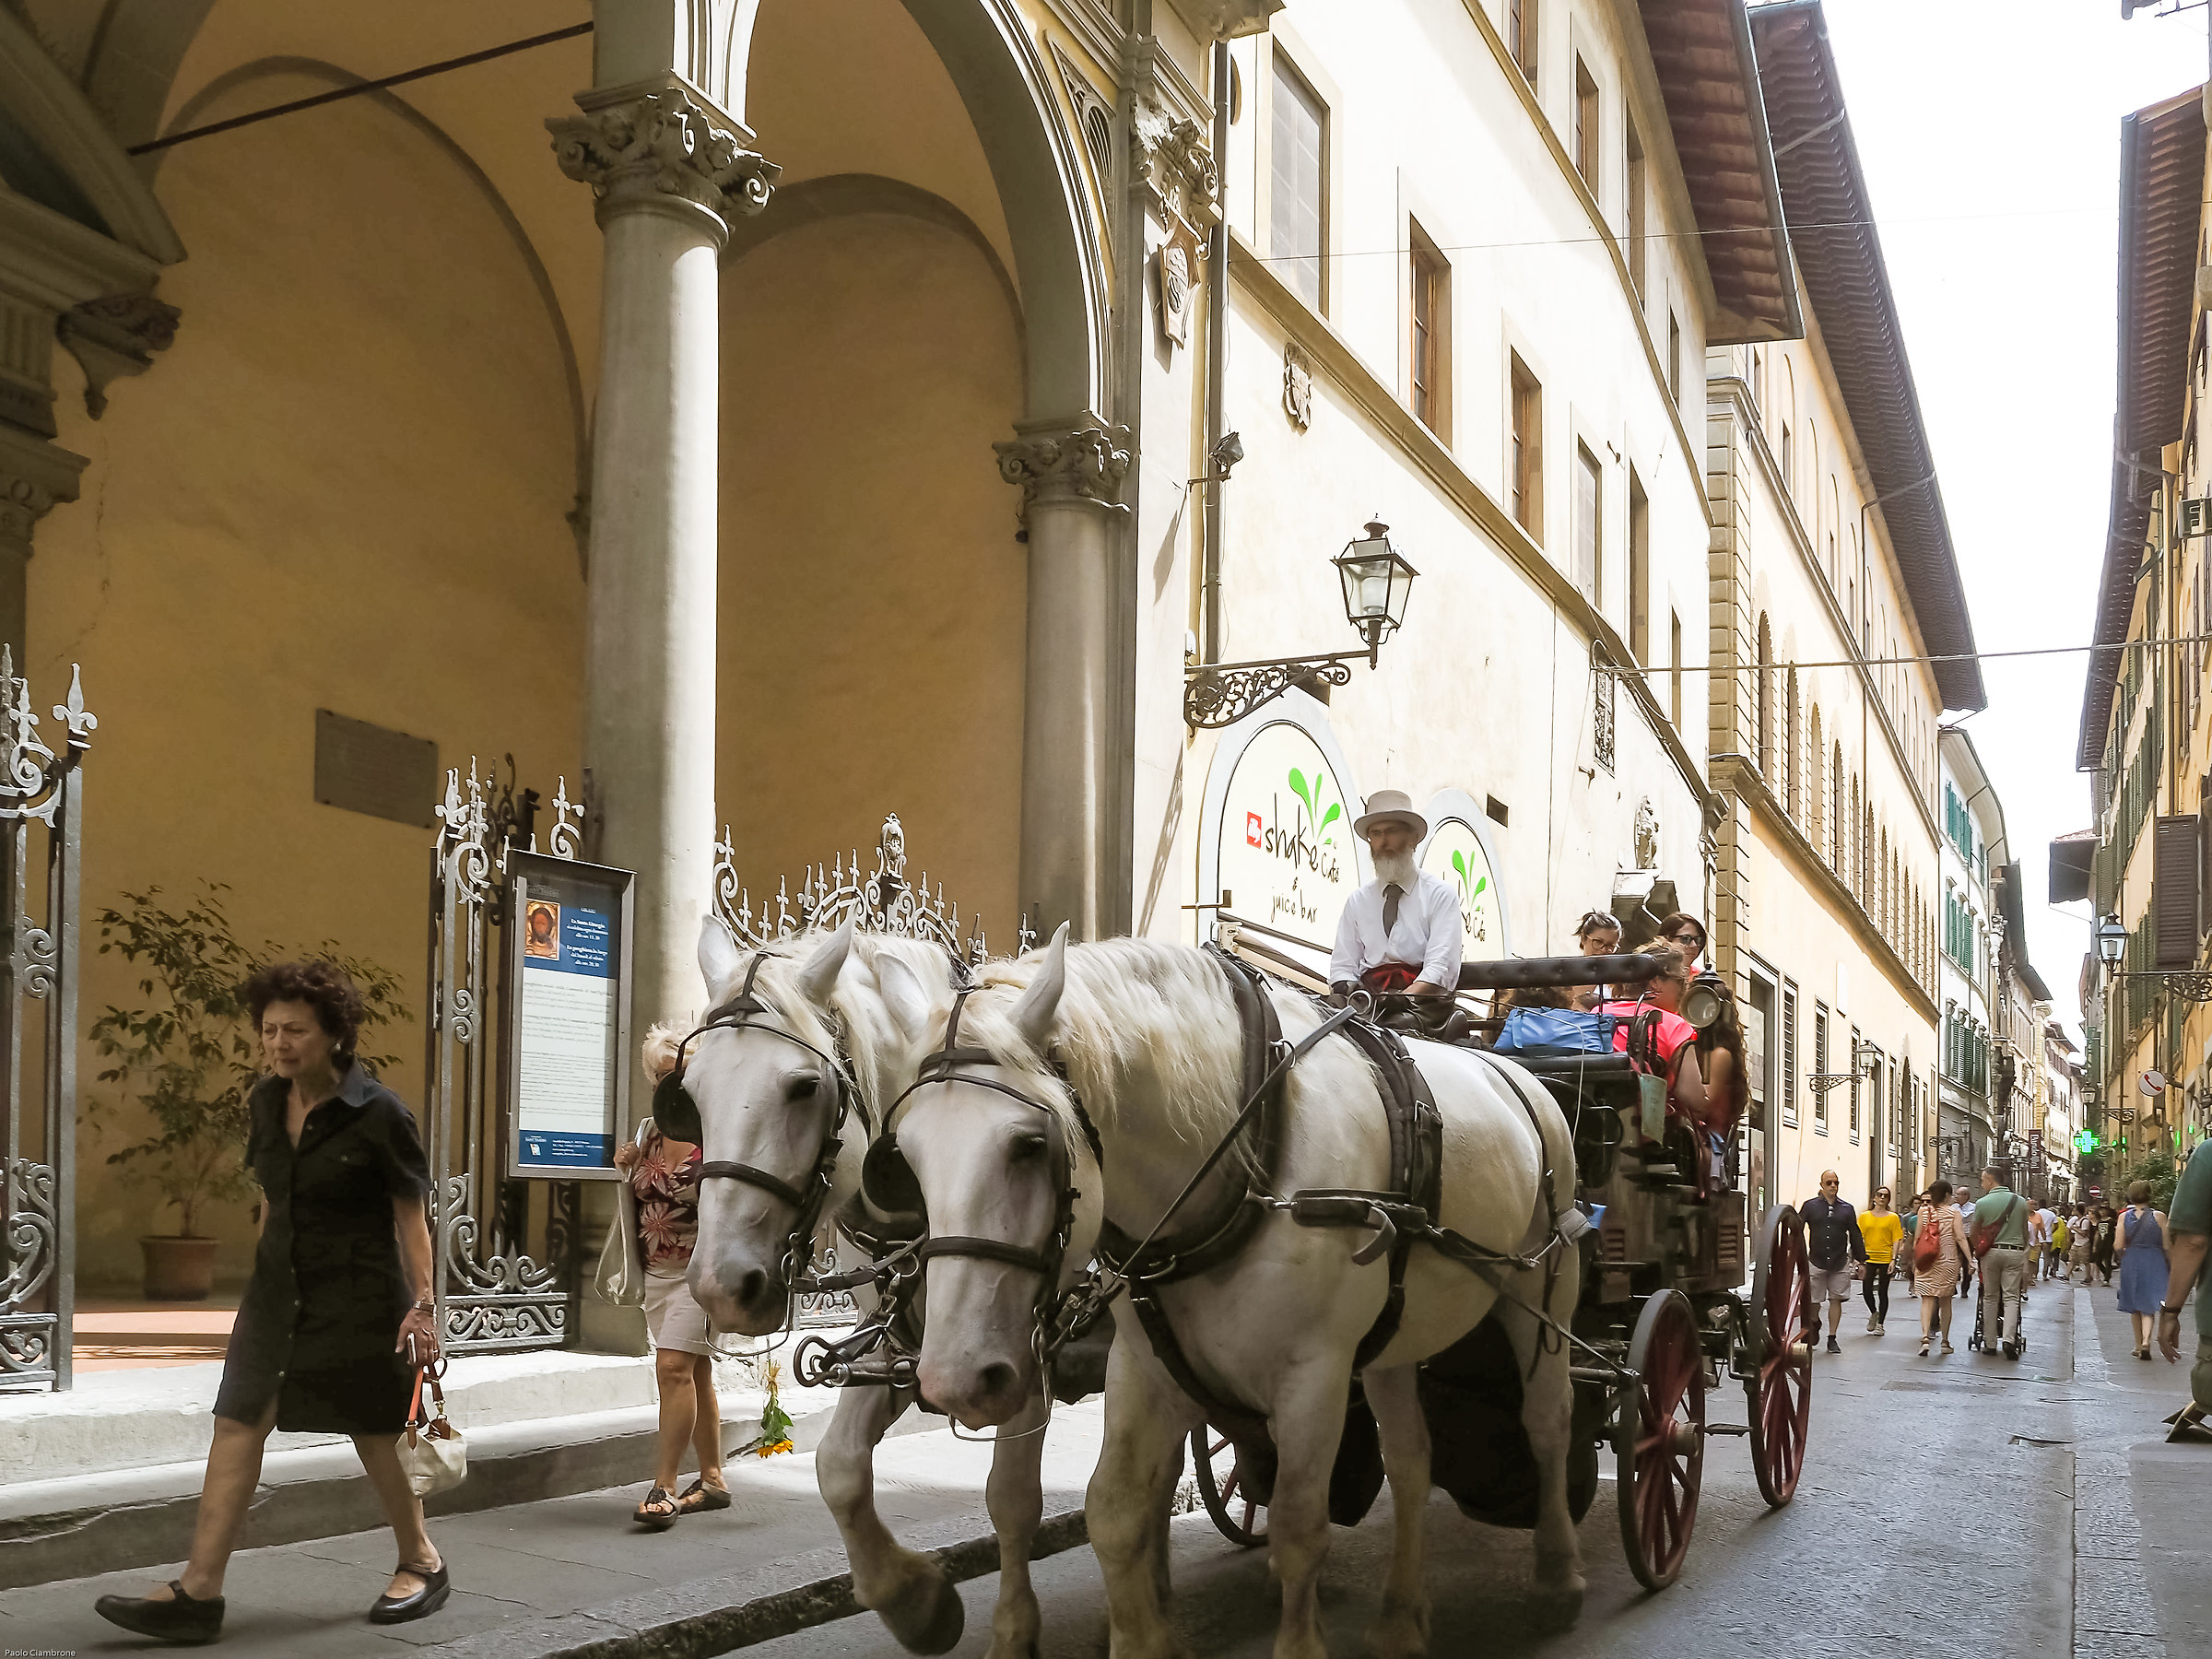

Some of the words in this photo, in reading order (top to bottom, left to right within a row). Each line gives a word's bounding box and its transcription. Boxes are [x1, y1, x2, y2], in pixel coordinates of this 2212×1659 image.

[1265, 792, 1318, 872] shake
[1271, 886, 1296, 923] juice
[1300, 888, 1318, 923] bar
